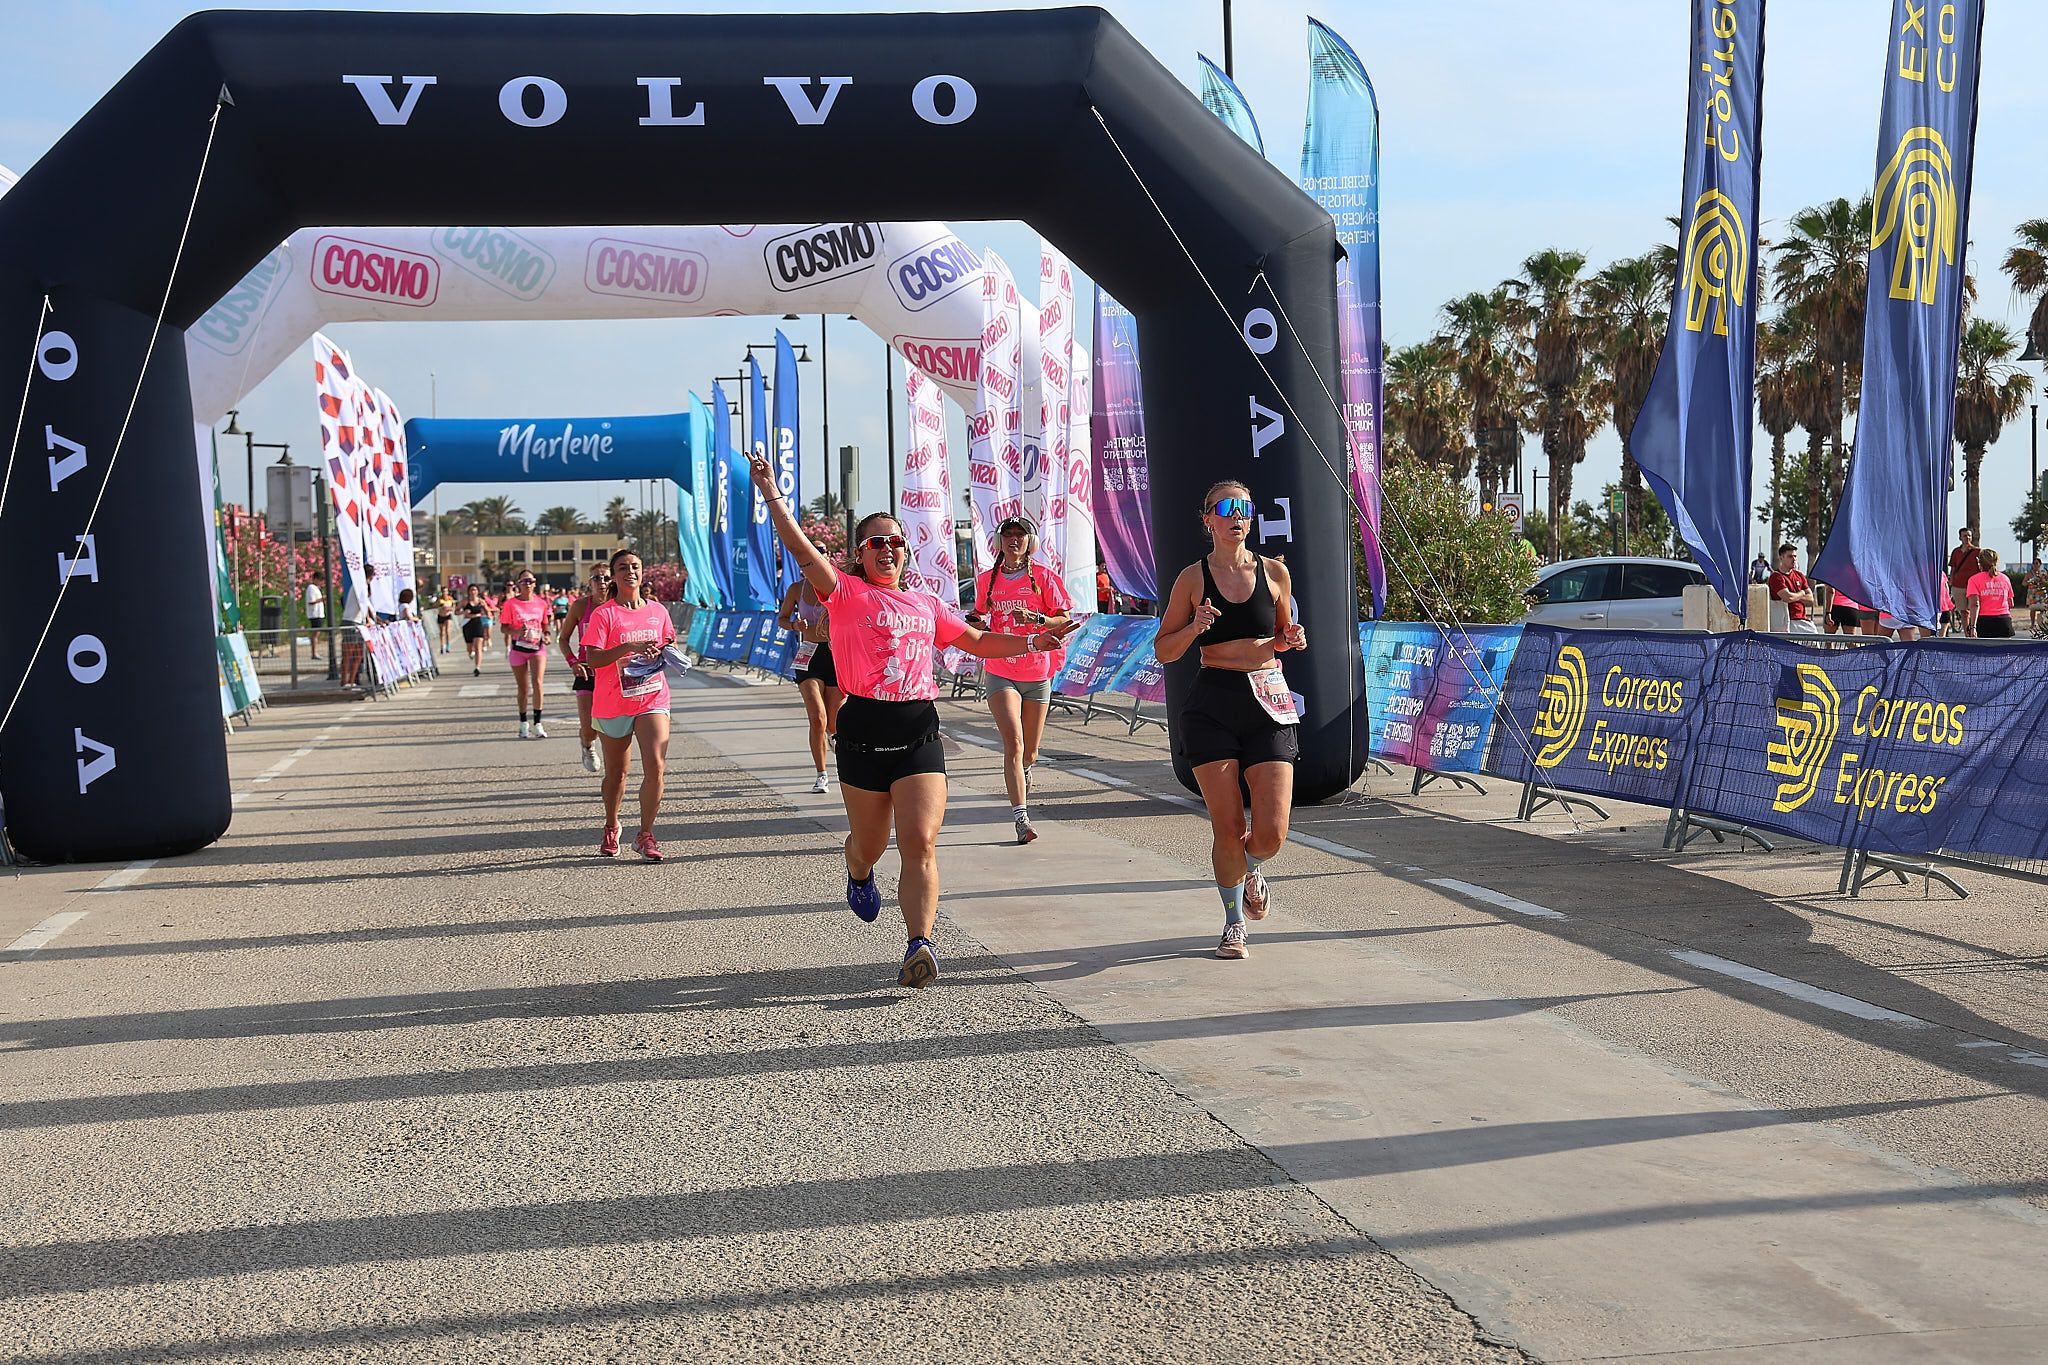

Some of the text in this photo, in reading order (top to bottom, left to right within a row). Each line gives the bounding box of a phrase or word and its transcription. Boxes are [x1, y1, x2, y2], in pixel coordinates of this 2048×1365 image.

[342, 74, 978, 128] VOLVO
[323, 244, 429, 300] COSMO
[443, 227, 545, 292] COSMO
[596, 246, 698, 296] COSMO
[776, 222, 875, 283] COSMO
[902, 341, 982, 382] COSM
[498, 422, 614, 473] Marlene
[37, 329, 117, 795] VOLVO
[876, 610, 933, 634] CARRERA
[1602, 665, 1683, 713] Correos
[1852, 685, 1967, 746] Correos
[1587, 719, 1669, 776] Express
[1833, 752, 1947, 822] Express
